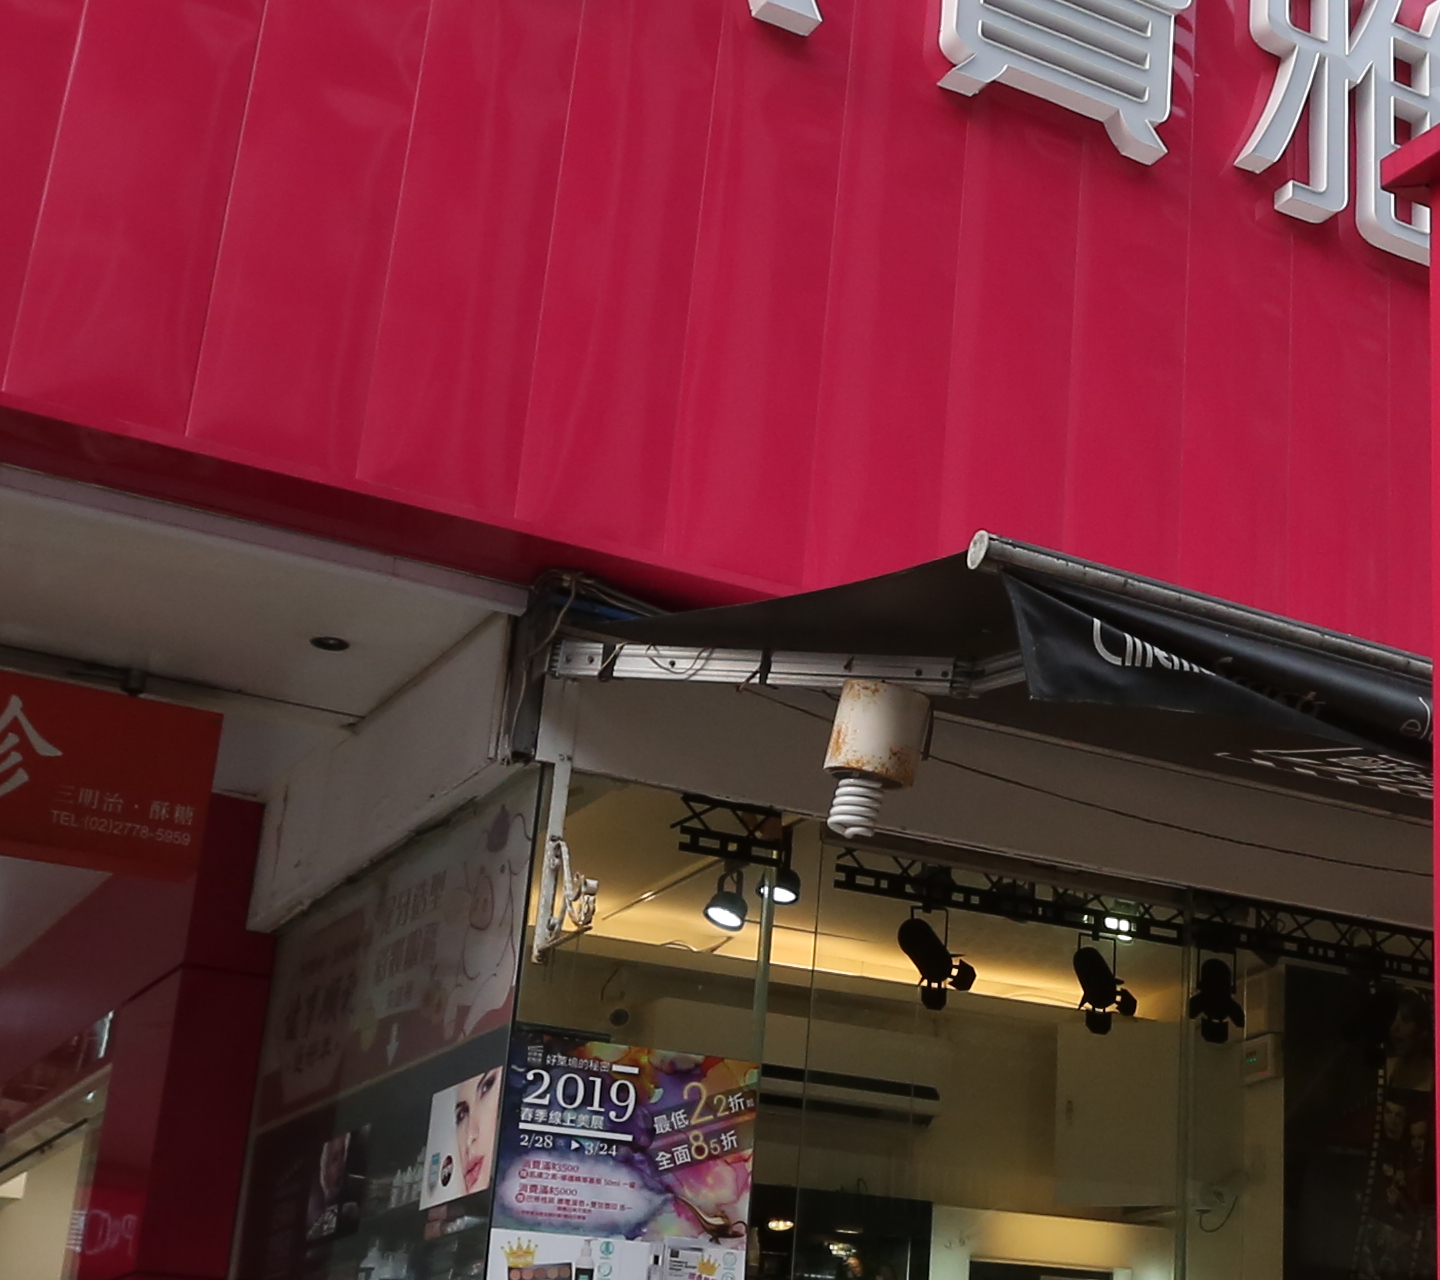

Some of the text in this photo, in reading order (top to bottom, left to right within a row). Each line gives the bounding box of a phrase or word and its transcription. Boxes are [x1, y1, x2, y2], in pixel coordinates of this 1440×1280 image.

[523, 1068, 637, 1124] 2019
[520, 1133, 619, 1157] 2/28 3/24
